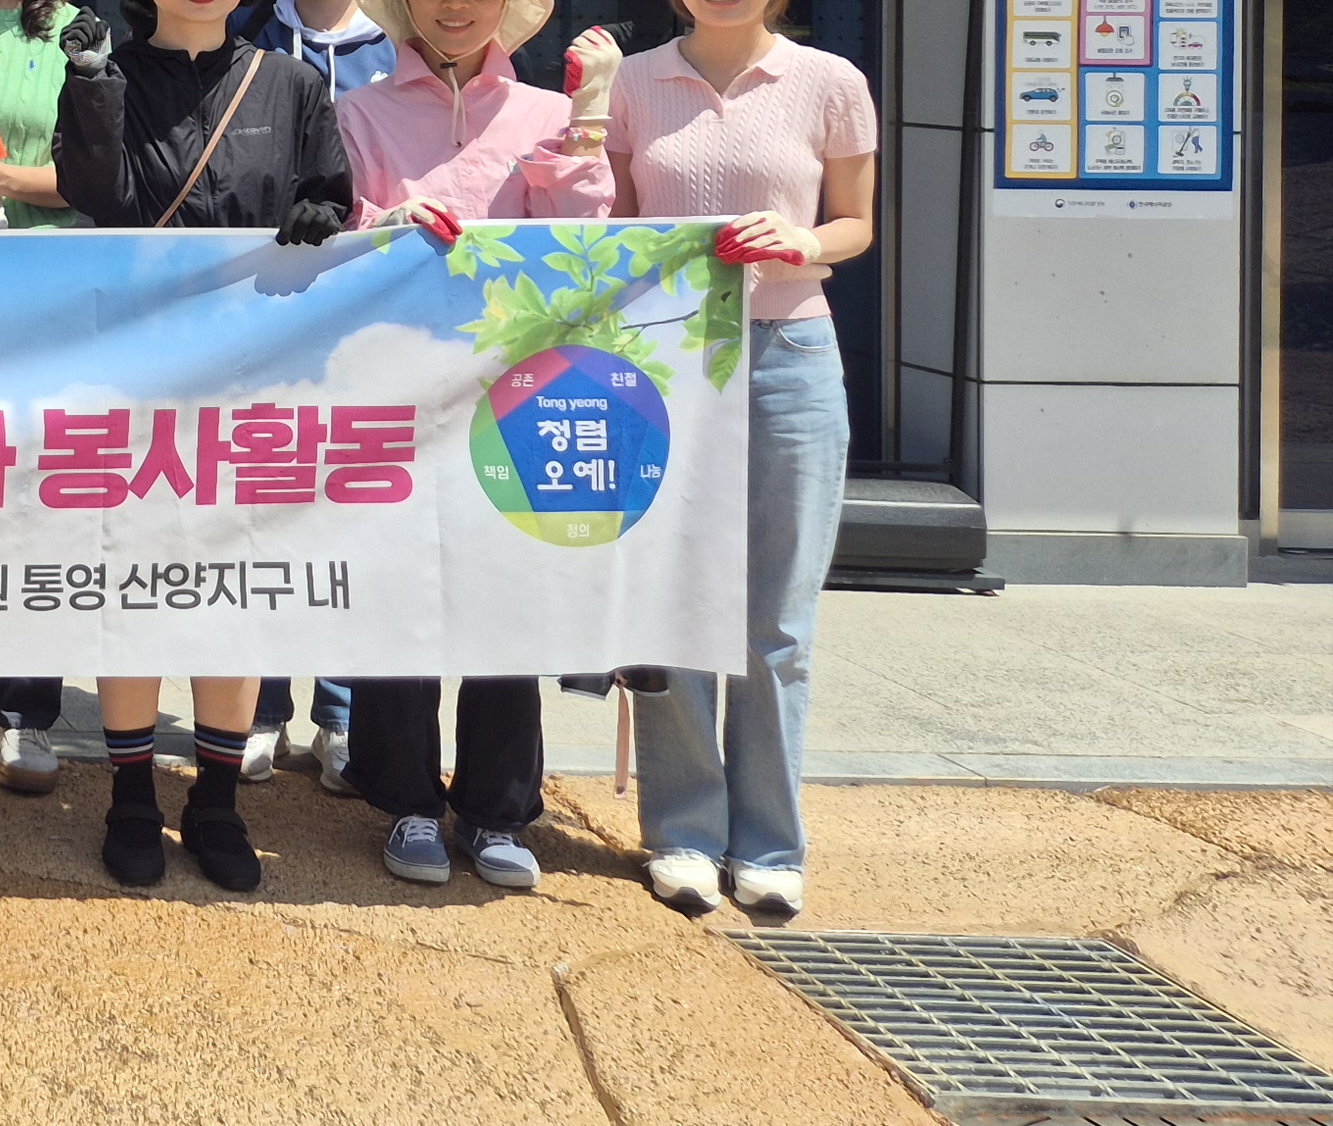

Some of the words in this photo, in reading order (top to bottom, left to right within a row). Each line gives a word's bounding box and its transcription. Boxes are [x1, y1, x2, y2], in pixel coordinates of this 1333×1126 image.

[610, 372, 637, 387] 친절
[537, 419, 608, 453] 청렴
[36, 403, 416, 509] 봉사활동
[484, 465, 510, 480] 책임
[566, 523, 590, 538] 정의
[21, 562, 106, 612] 통영
[117, 561, 294, 612] 산양지구
[303, 560, 351, 610] 내
